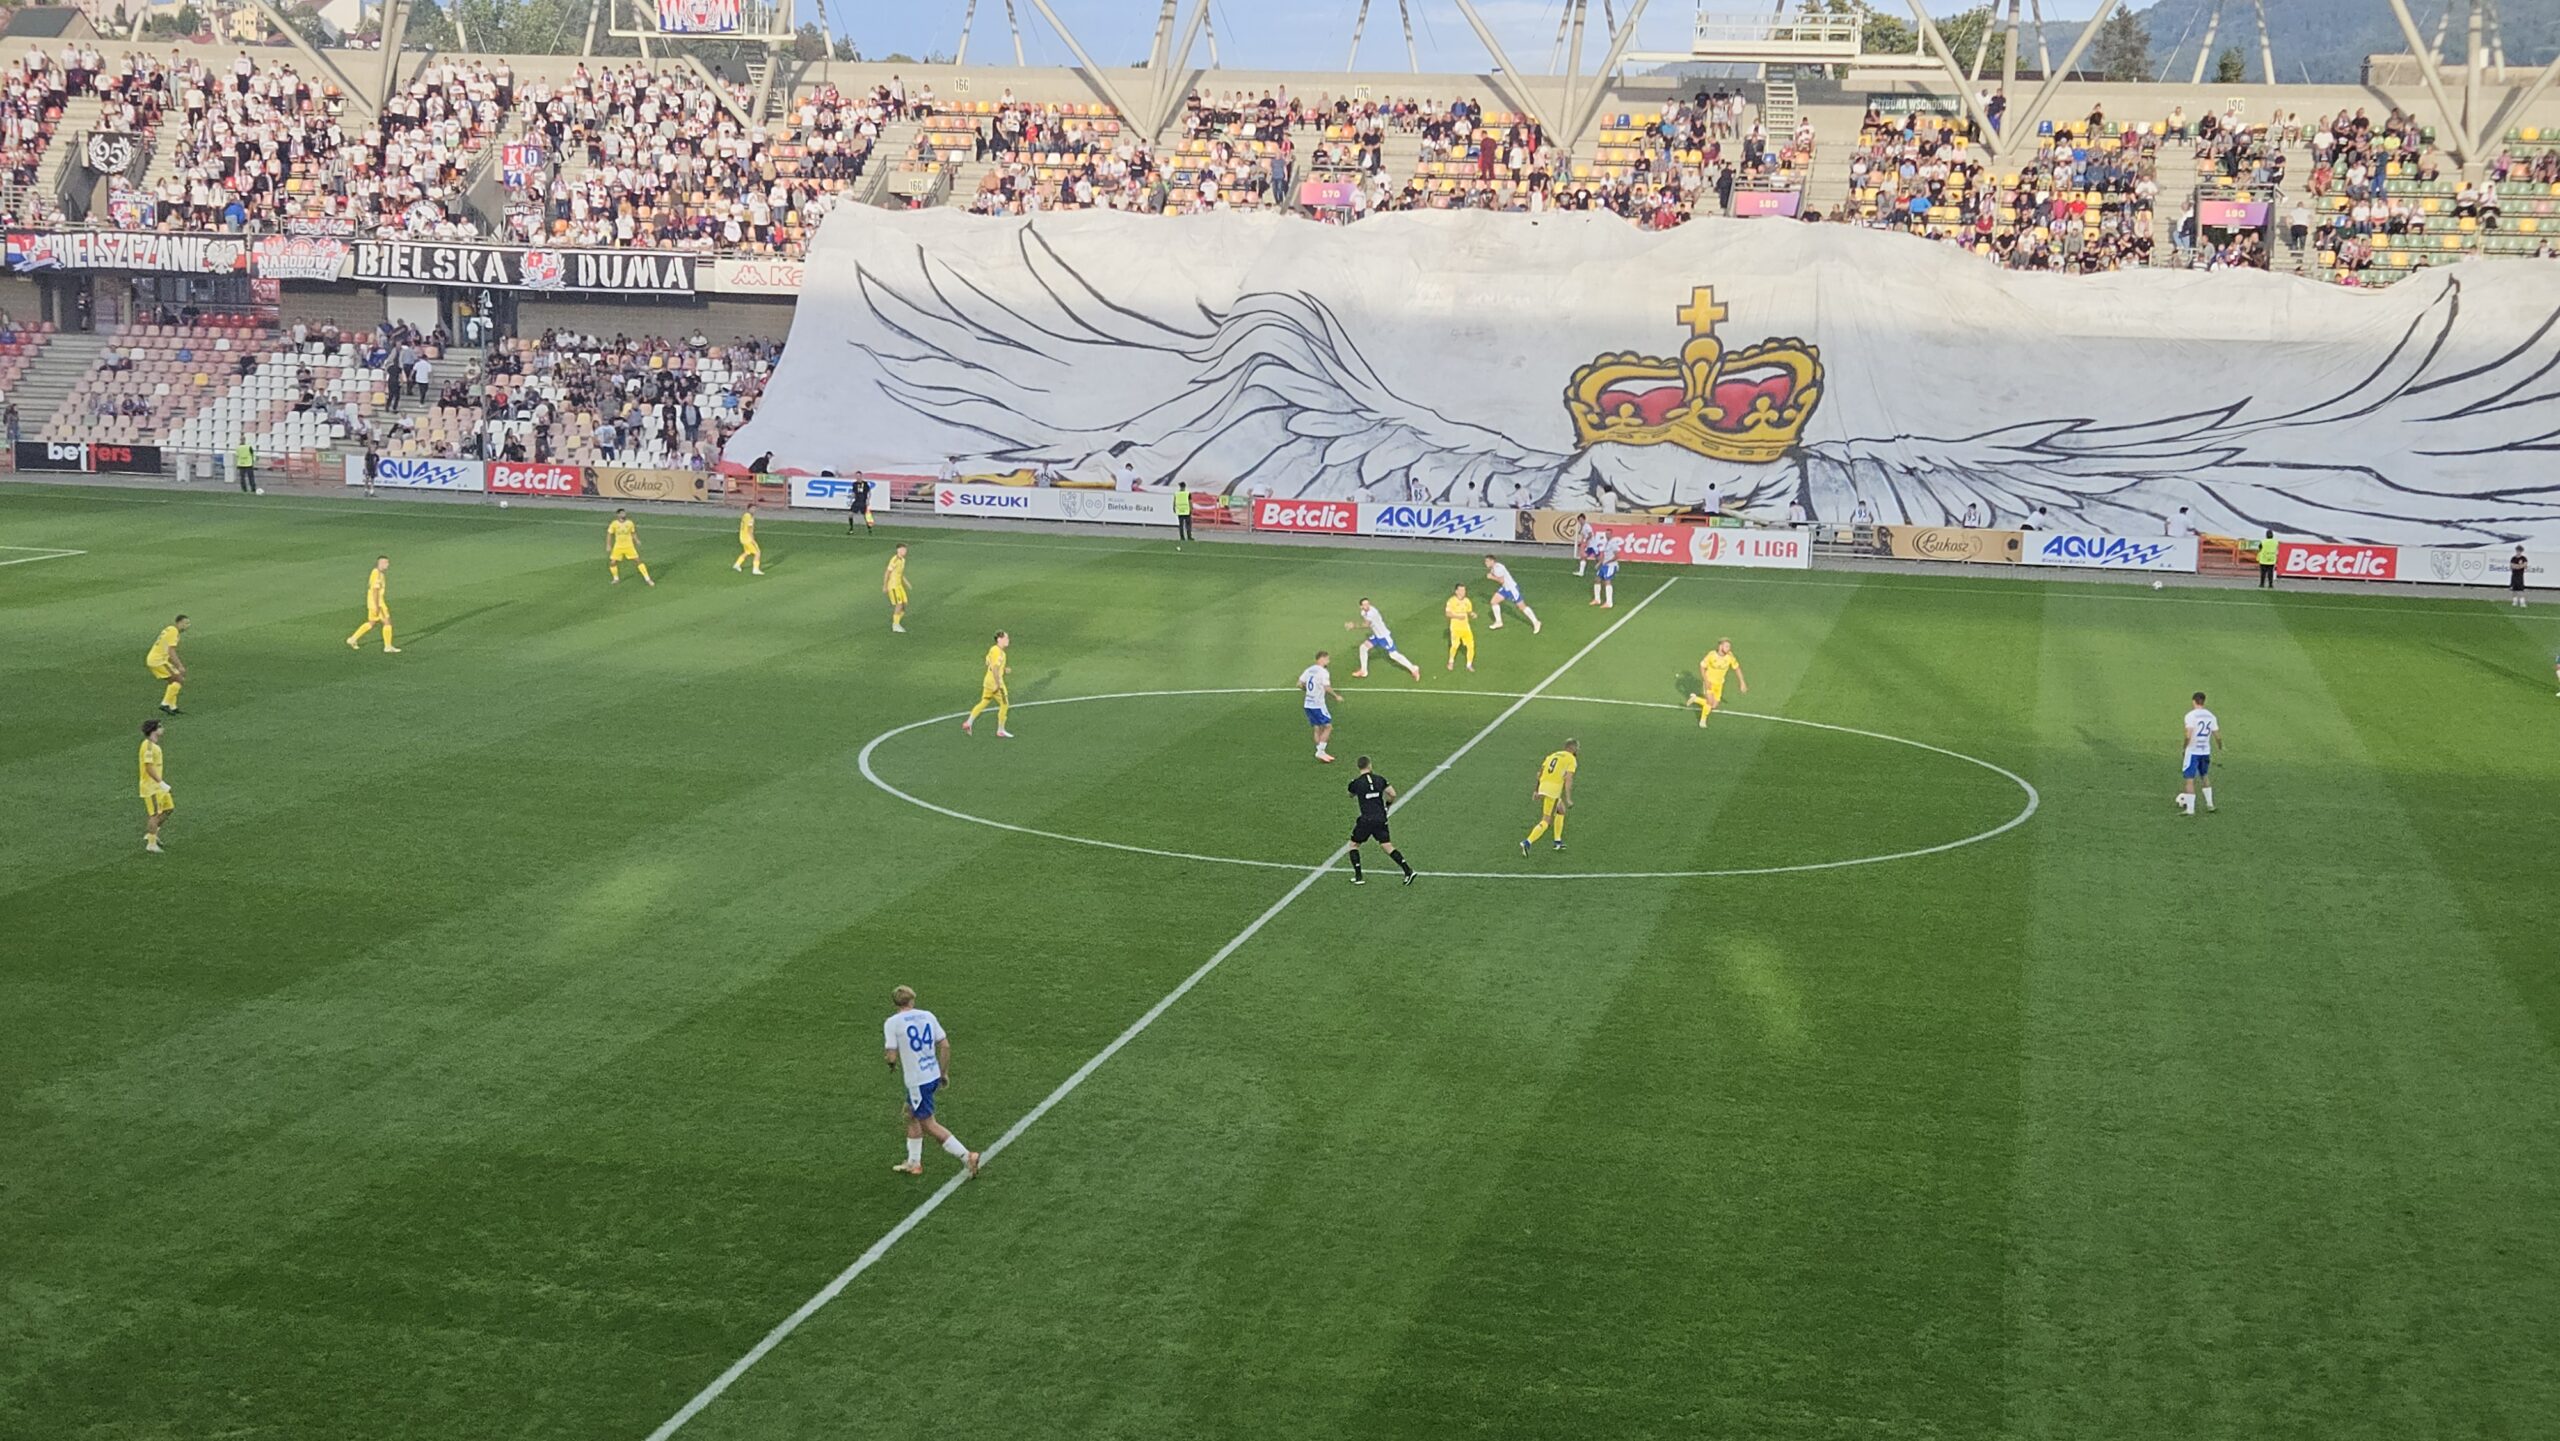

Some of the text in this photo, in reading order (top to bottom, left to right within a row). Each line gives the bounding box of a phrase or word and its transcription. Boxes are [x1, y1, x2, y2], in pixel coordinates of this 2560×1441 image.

[96, 141, 123, 164] 95
[50, 232, 211, 272] BIELSZCZANIE
[257, 255, 338, 270] NARODOWE
[357, 244, 689, 289] BIELSKA DUMA
[47, 441, 132, 472] betters
[492, 466, 573, 491] Betclic
[959, 493, 1029, 508] SUZUKI
[1261, 502, 1349, 528] Betclic
[1736, 539, 1798, 558] 1 LIGA
[2285, 548, 2388, 576] Betclic
[1307, 675, 1315, 692] 6
[1547, 757, 1559, 774] 9
[906, 1022, 933, 1052] 84
